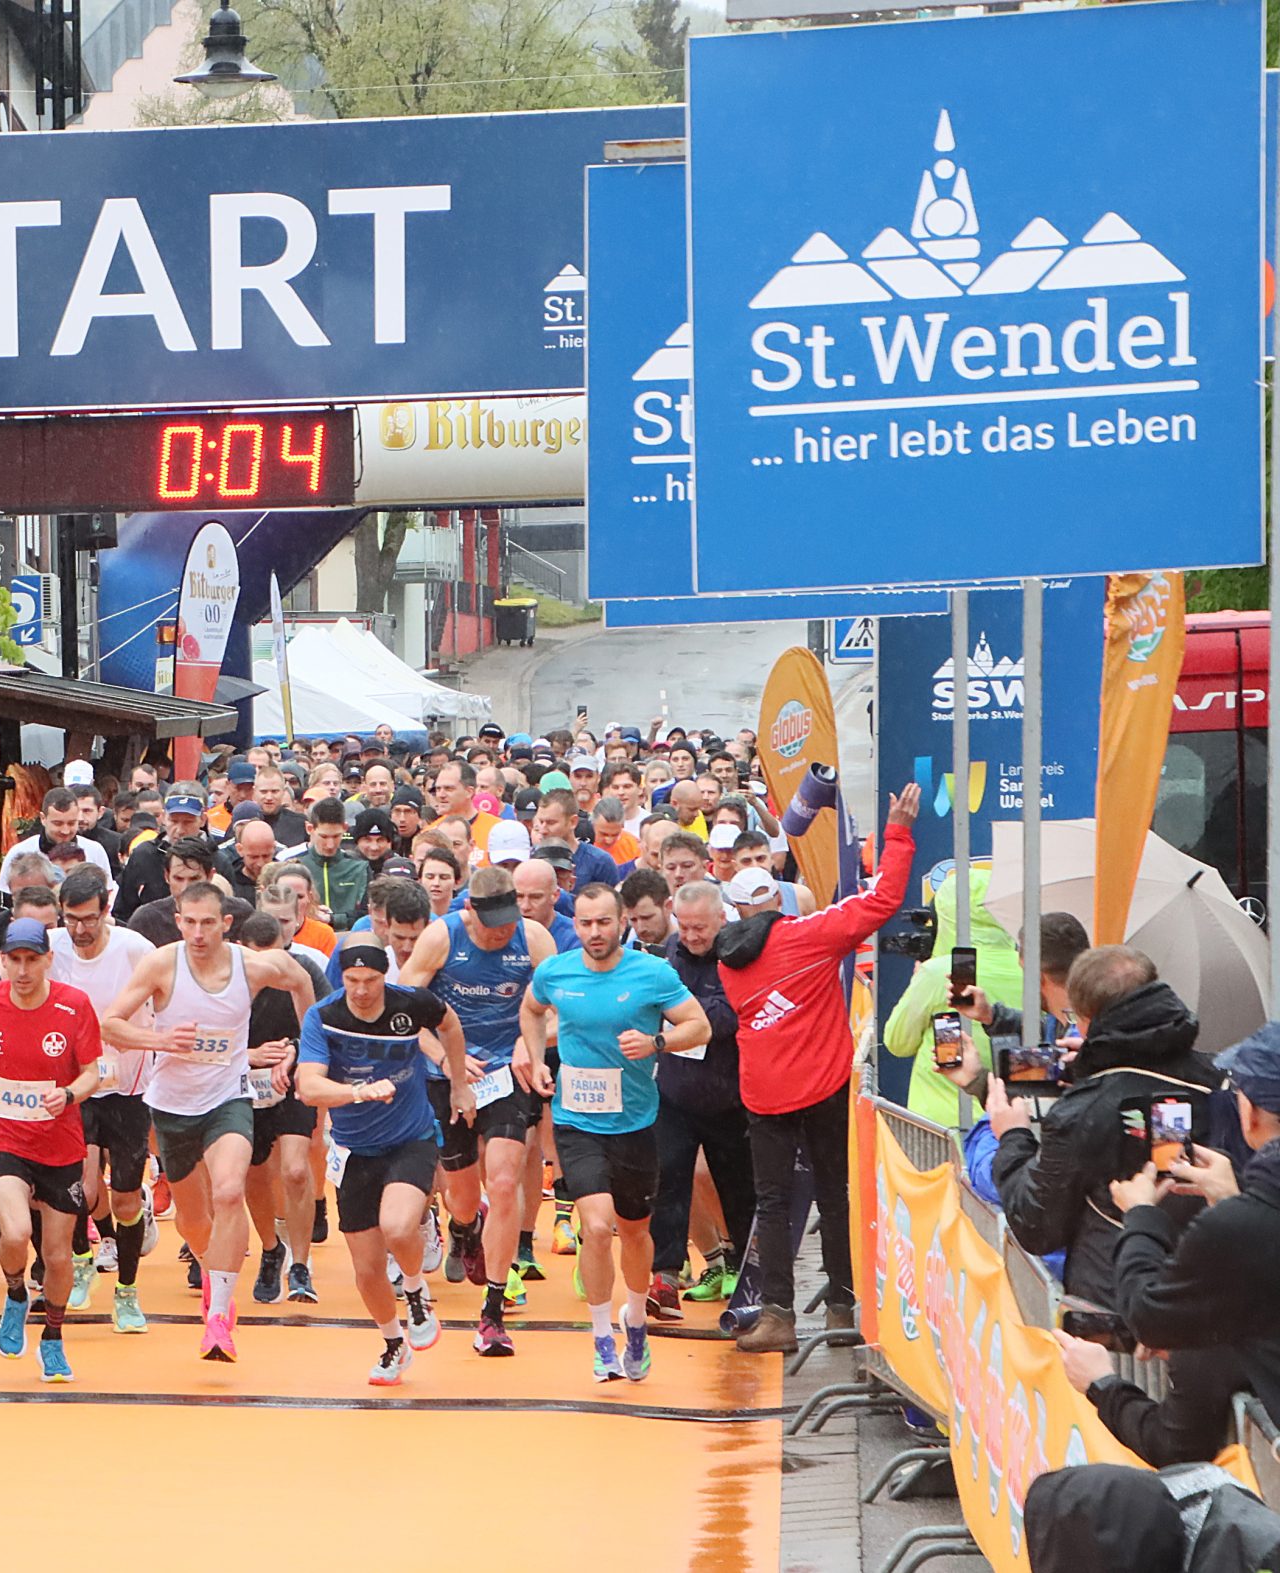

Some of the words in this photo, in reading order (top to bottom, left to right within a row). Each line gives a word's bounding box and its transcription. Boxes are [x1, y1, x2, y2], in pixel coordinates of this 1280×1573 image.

[560, 335, 585, 349] hie
[423, 399, 585, 454] Bitburge
[794, 426, 878, 463] hier
[889, 419, 972, 459] lebt
[981, 415, 1055, 453] das
[1067, 407, 1197, 448] Leben
[158, 423, 325, 499] 0:04
[189, 570, 237, 604] Bitburger
[204, 604, 221, 624] 0.0
[771, 708, 812, 752] Globus
[1000, 761, 1065, 776] Lanreis
[1000, 793, 1054, 809] Weel
[452, 983, 491, 997] Apollo
[571, 1078, 607, 1091] FABIAN
[573, 1092, 605, 1104] 4138
